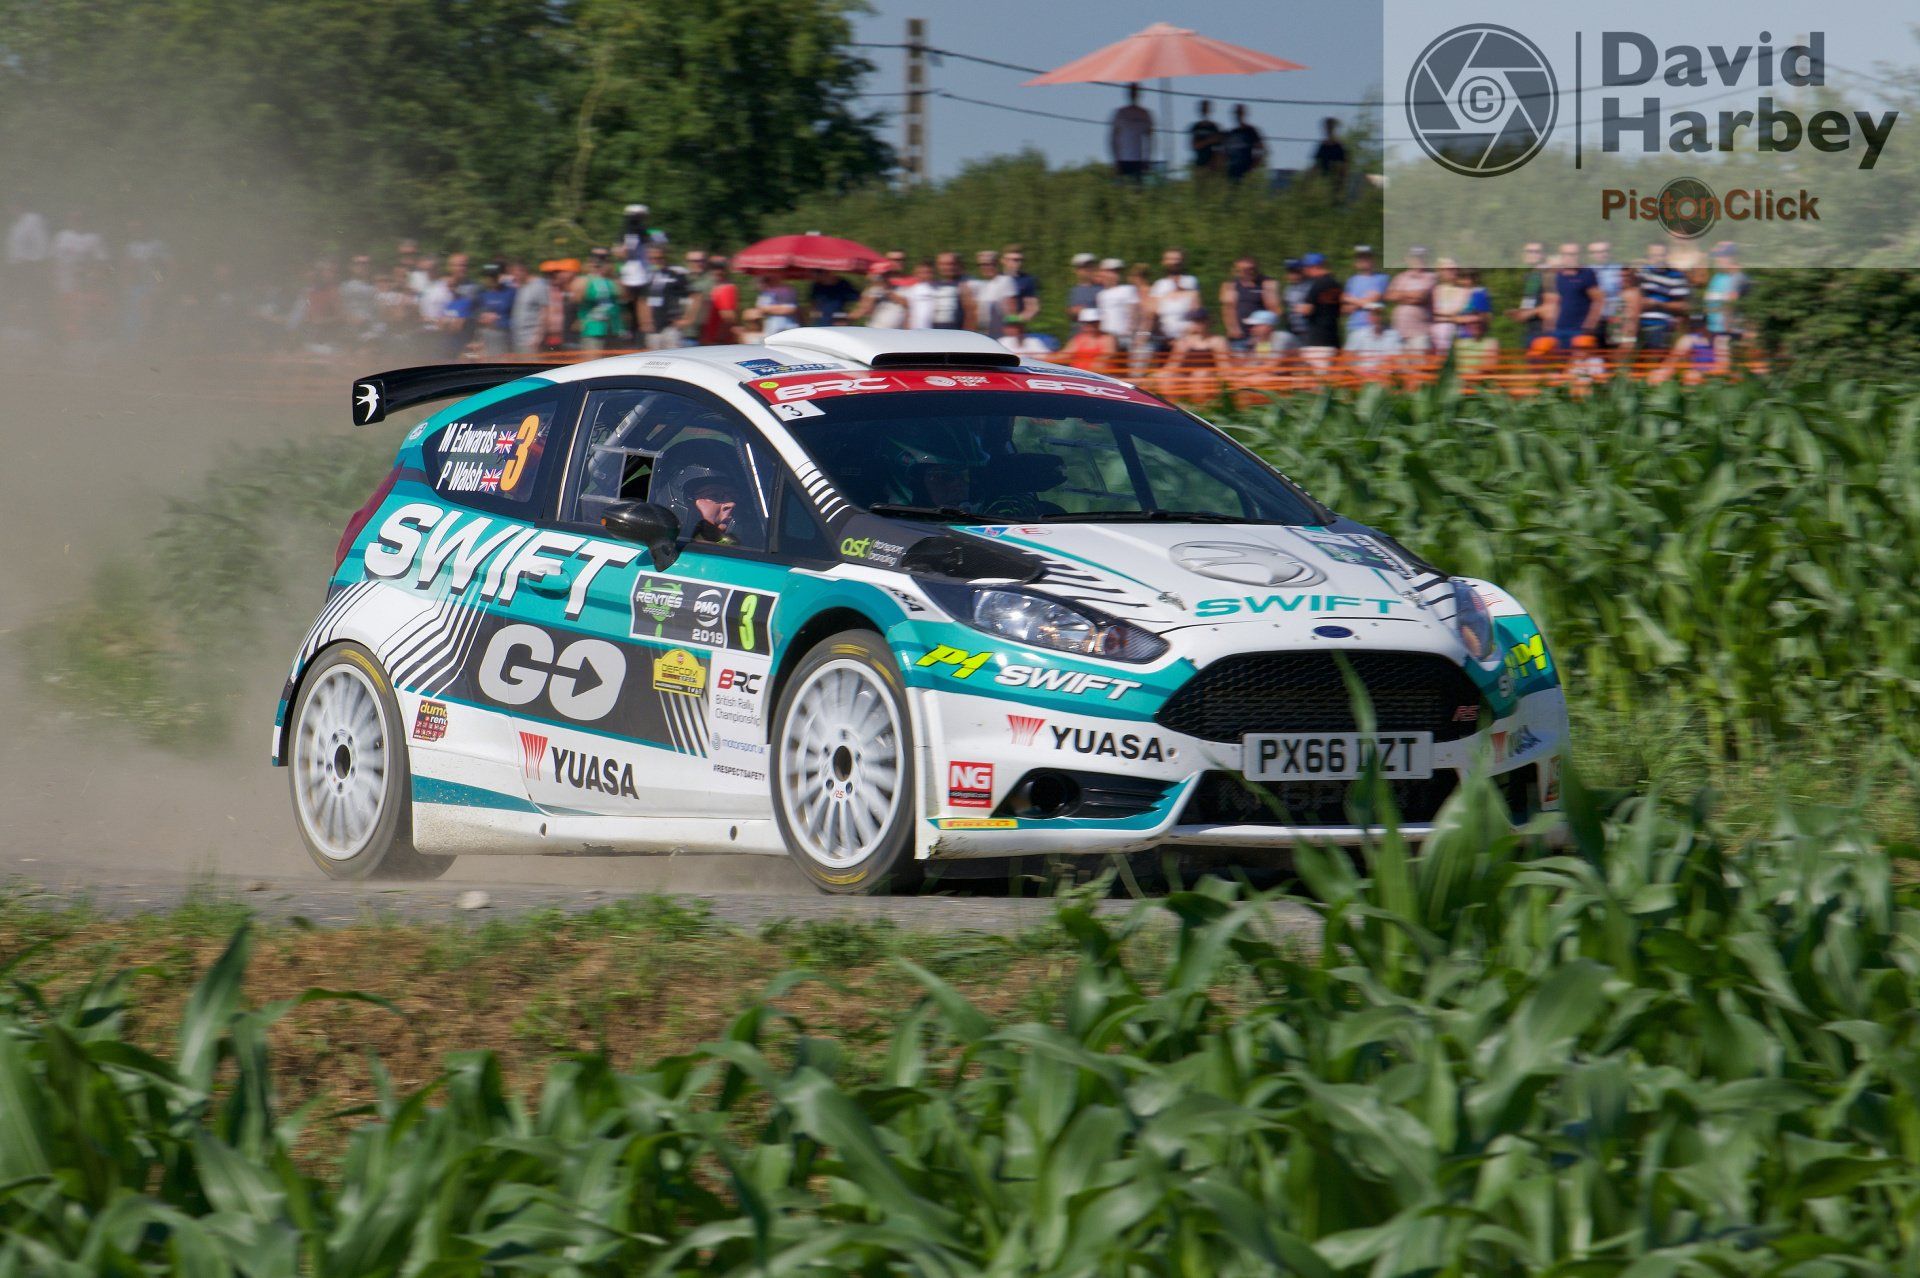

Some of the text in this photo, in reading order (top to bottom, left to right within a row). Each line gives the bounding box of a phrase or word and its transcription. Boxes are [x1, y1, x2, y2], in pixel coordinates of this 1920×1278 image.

[775, 377, 890, 401] BRC
[1026, 379, 1130, 400] BRC
[782, 404, 803, 417] 3
[438, 423, 458, 453] M
[450, 423, 498, 454] Edwards
[500, 414, 540, 491] 3
[436, 460, 484, 492] P Walsh
[364, 503, 644, 619] SWIFT
[636, 591, 684, 609] RENTIES
[693, 600, 720, 616] PMO
[1195, 594, 1404, 618] SWIFT
[692, 628, 724, 645] 2019
[739, 594, 758, 651] 3
[479, 624, 627, 721] GO
[916, 643, 994, 680] P1
[717, 668, 762, 695] BRC
[995, 664, 1143, 701] SWIFT
[1051, 725, 1164, 763] YUASA
[1260, 738, 1345, 773] PX66
[551, 746, 640, 800] YUASA
[951, 765, 992, 790] NG
